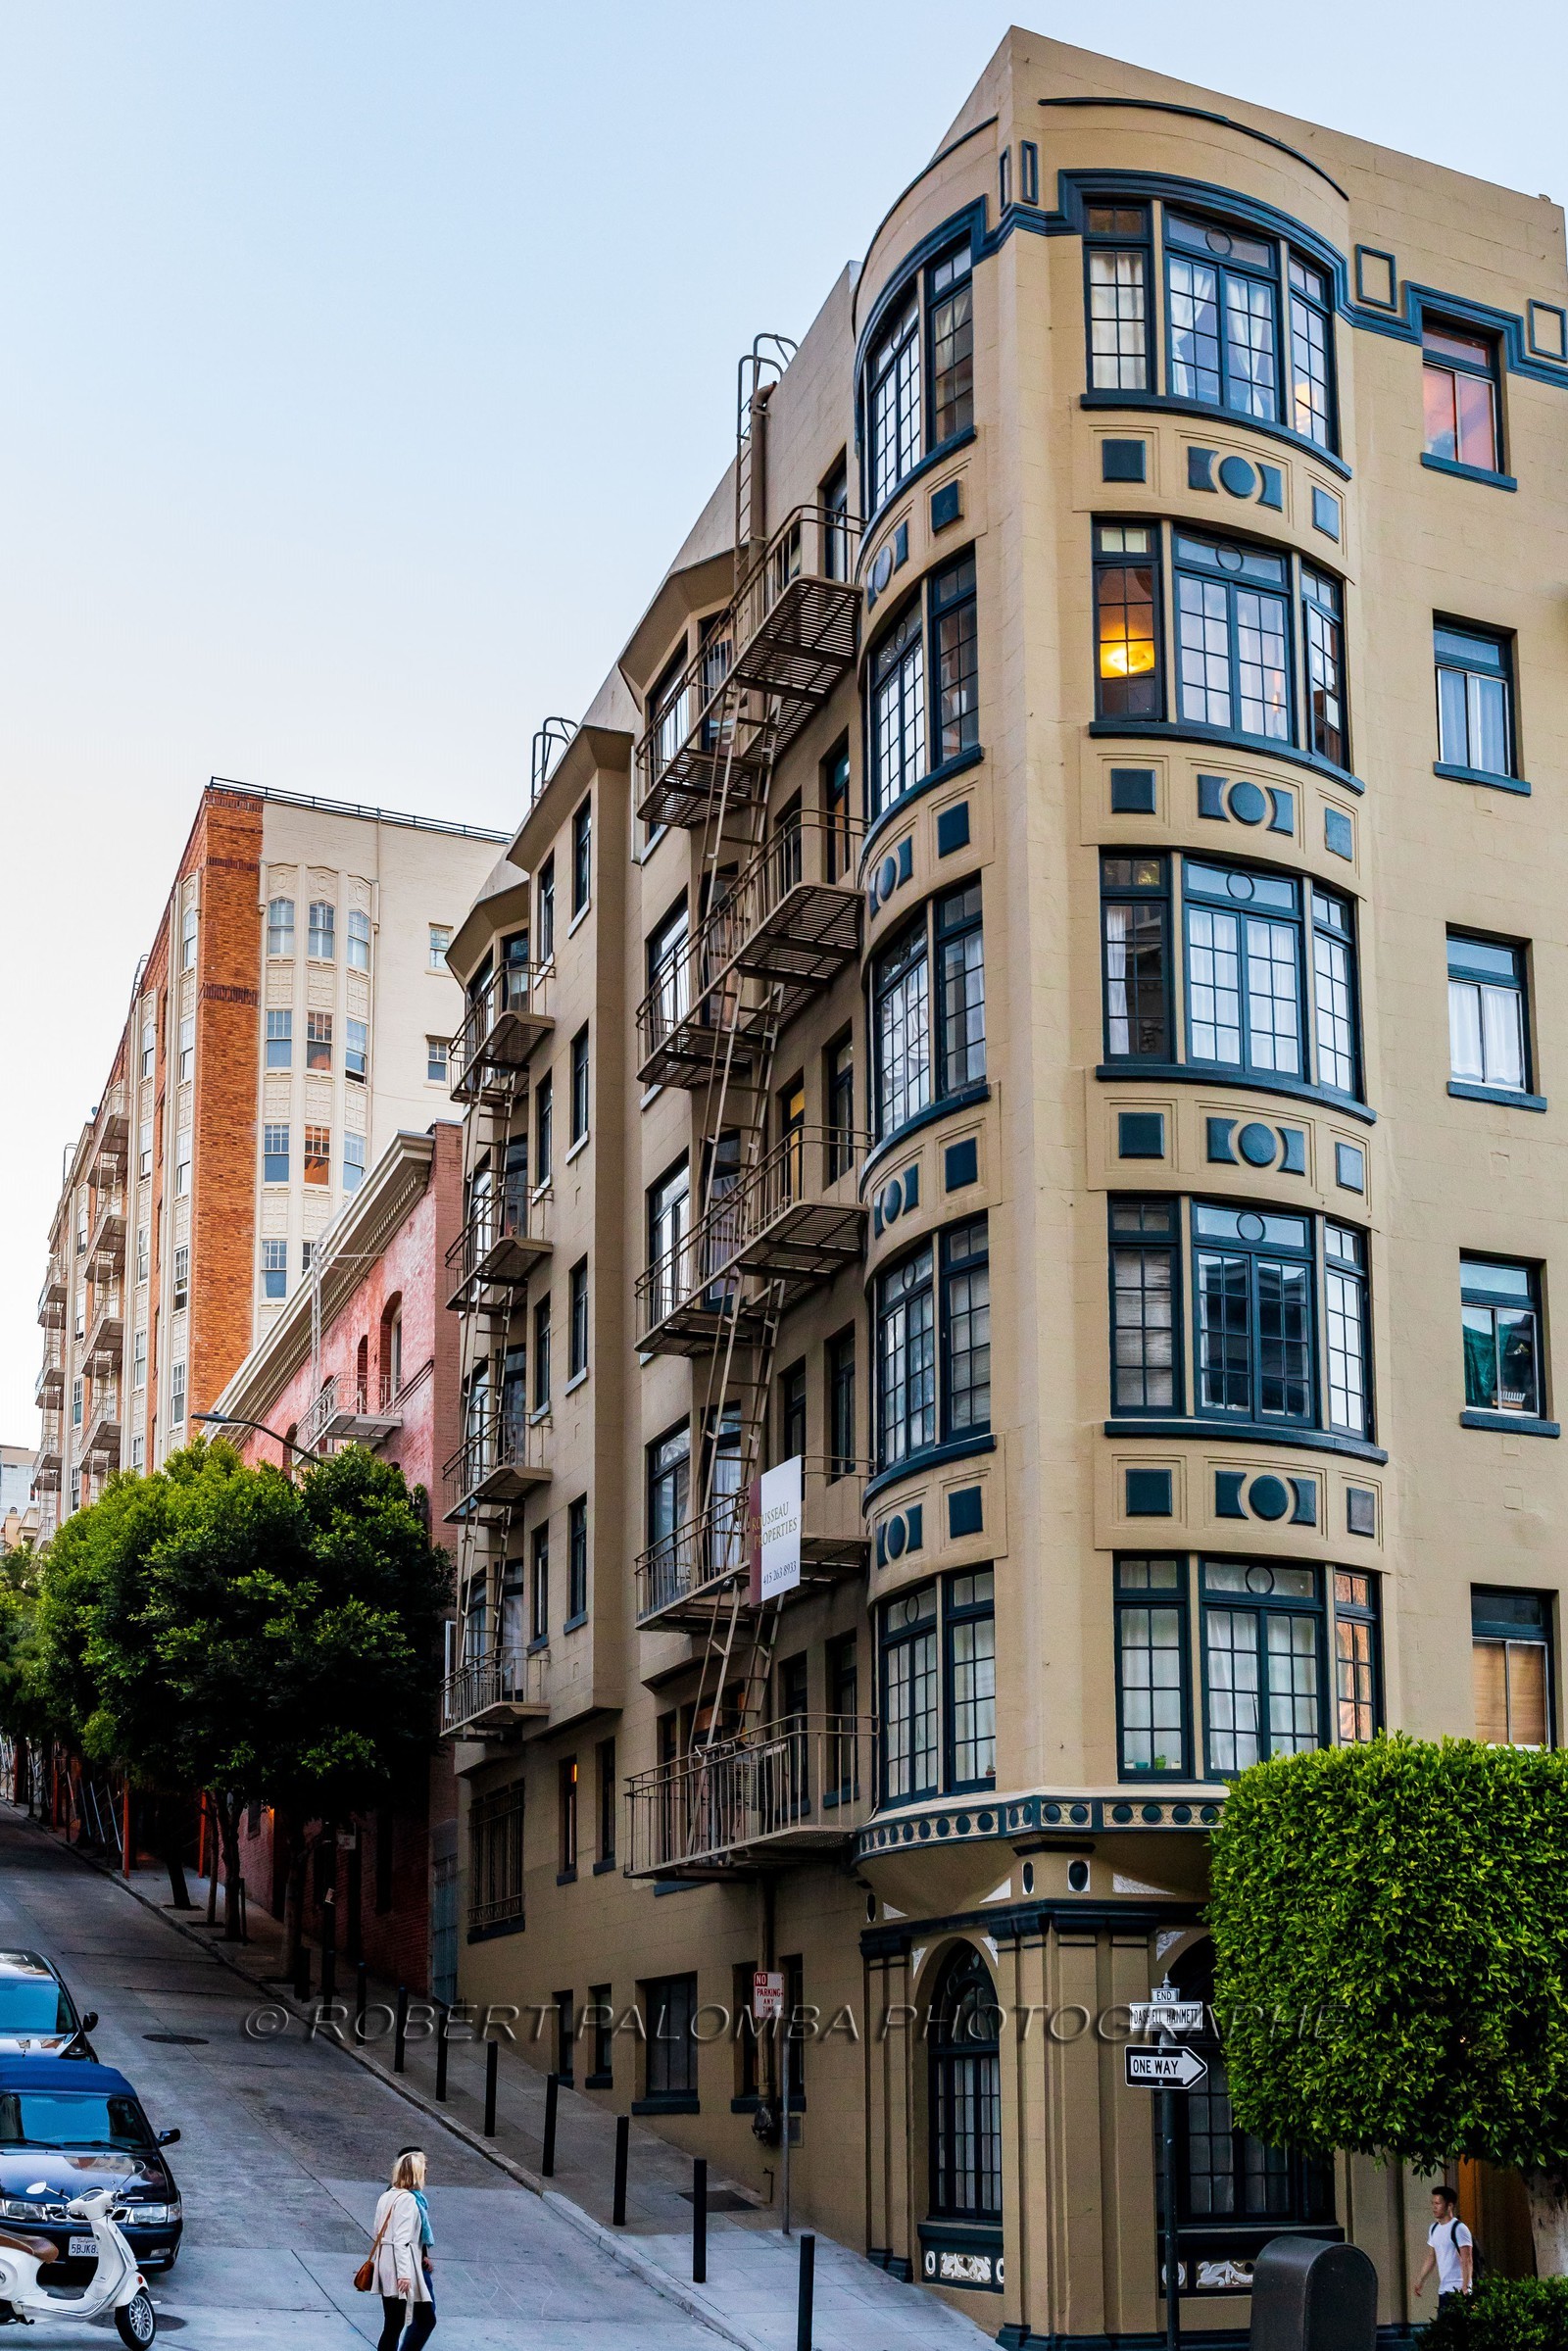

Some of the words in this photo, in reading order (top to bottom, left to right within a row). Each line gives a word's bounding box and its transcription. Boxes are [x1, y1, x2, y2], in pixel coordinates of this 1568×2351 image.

[752, 1501, 789, 1532] ROUSSEAU
[754, 1517, 798, 1549] PROPERTIES
[762, 1572, 772, 1585] 415
[773, 1567, 783, 1581] 263
[784, 1560, 797, 1576] 8933
[756, 1974, 766, 1985] NO
[757, 1987, 781, 1997] PARKING
[1156, 1991, 1172, 2000] END
[1134, 2010, 1162, 2024] DASHIELL
[1166, 2009, 1198, 2024] HAMMETT
[1133, 2059, 1152, 2074] ONE
[1154, 2060, 1179, 2075] WAY
[72, 2244, 99, 2254] 5BJK8
